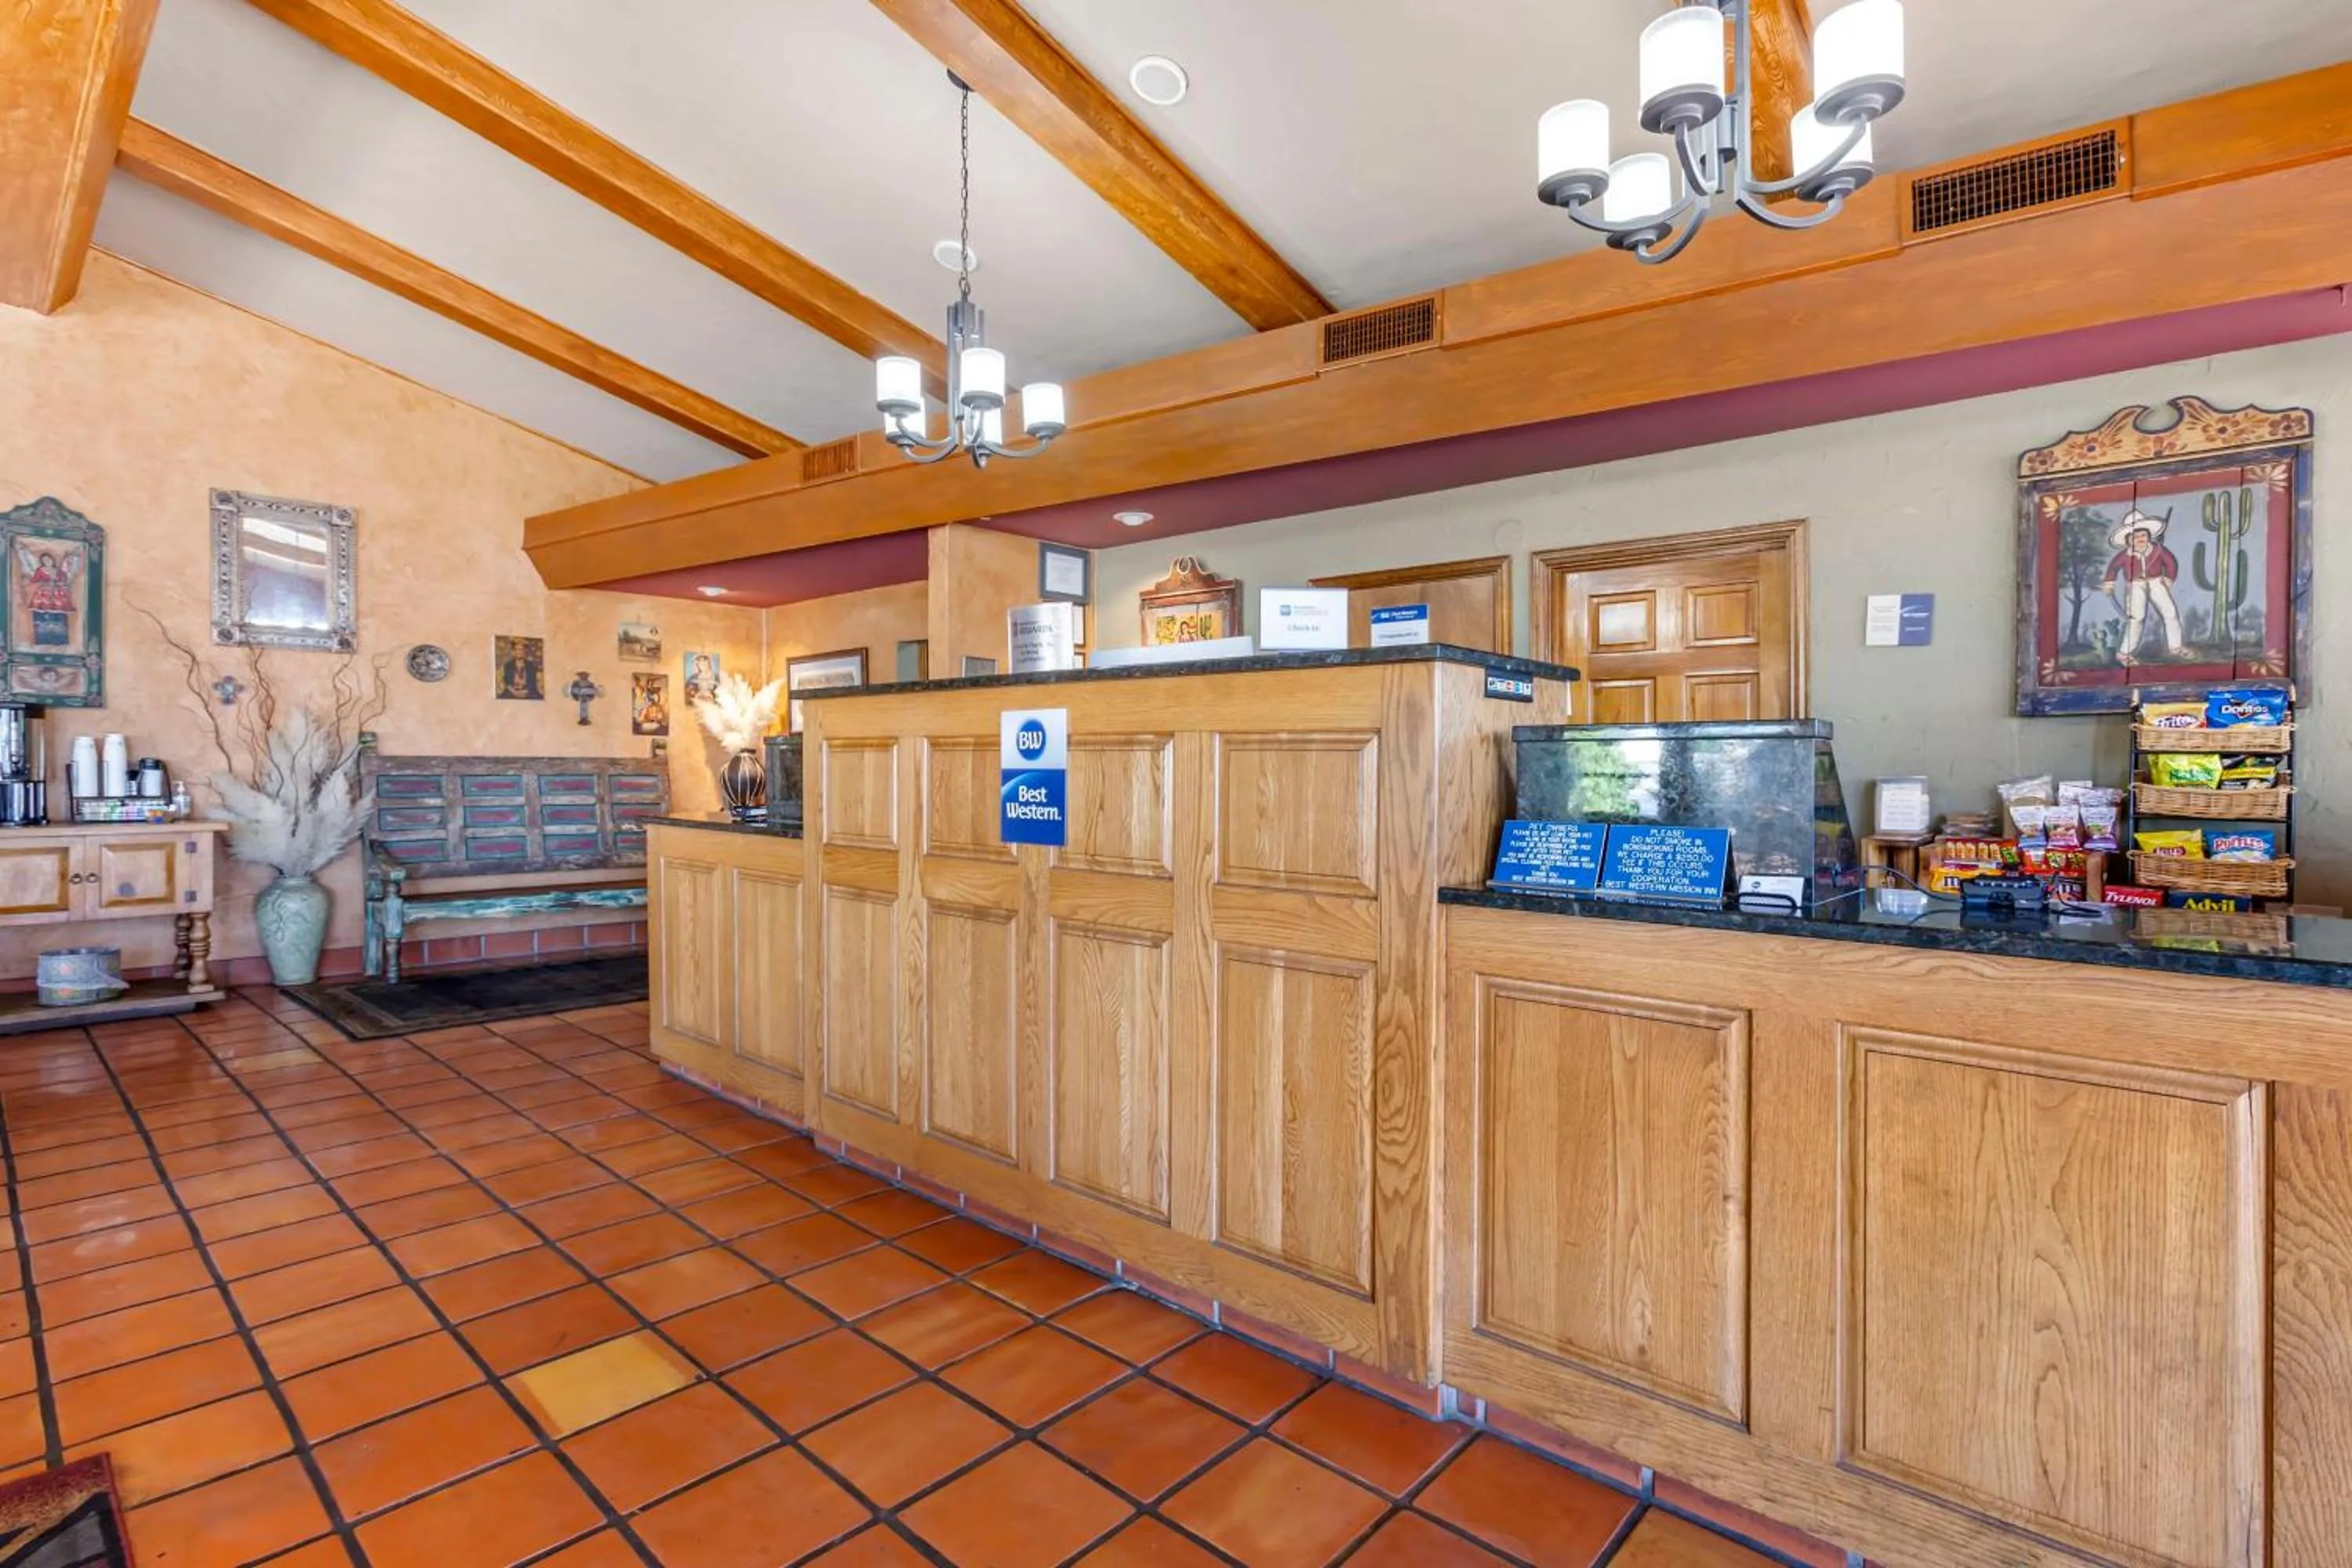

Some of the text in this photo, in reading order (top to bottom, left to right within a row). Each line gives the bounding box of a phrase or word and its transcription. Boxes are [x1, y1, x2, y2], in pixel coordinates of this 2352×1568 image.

[2221, 704, 2269, 715] Doritos
[1018, 730, 1043, 750] BW
[1018, 785, 1048, 803] Best
[1664, 837, 1692, 846] SMOKE
[2106, 891, 2158, 906] TYLENOL
[2183, 898, 2235, 913] Advil
